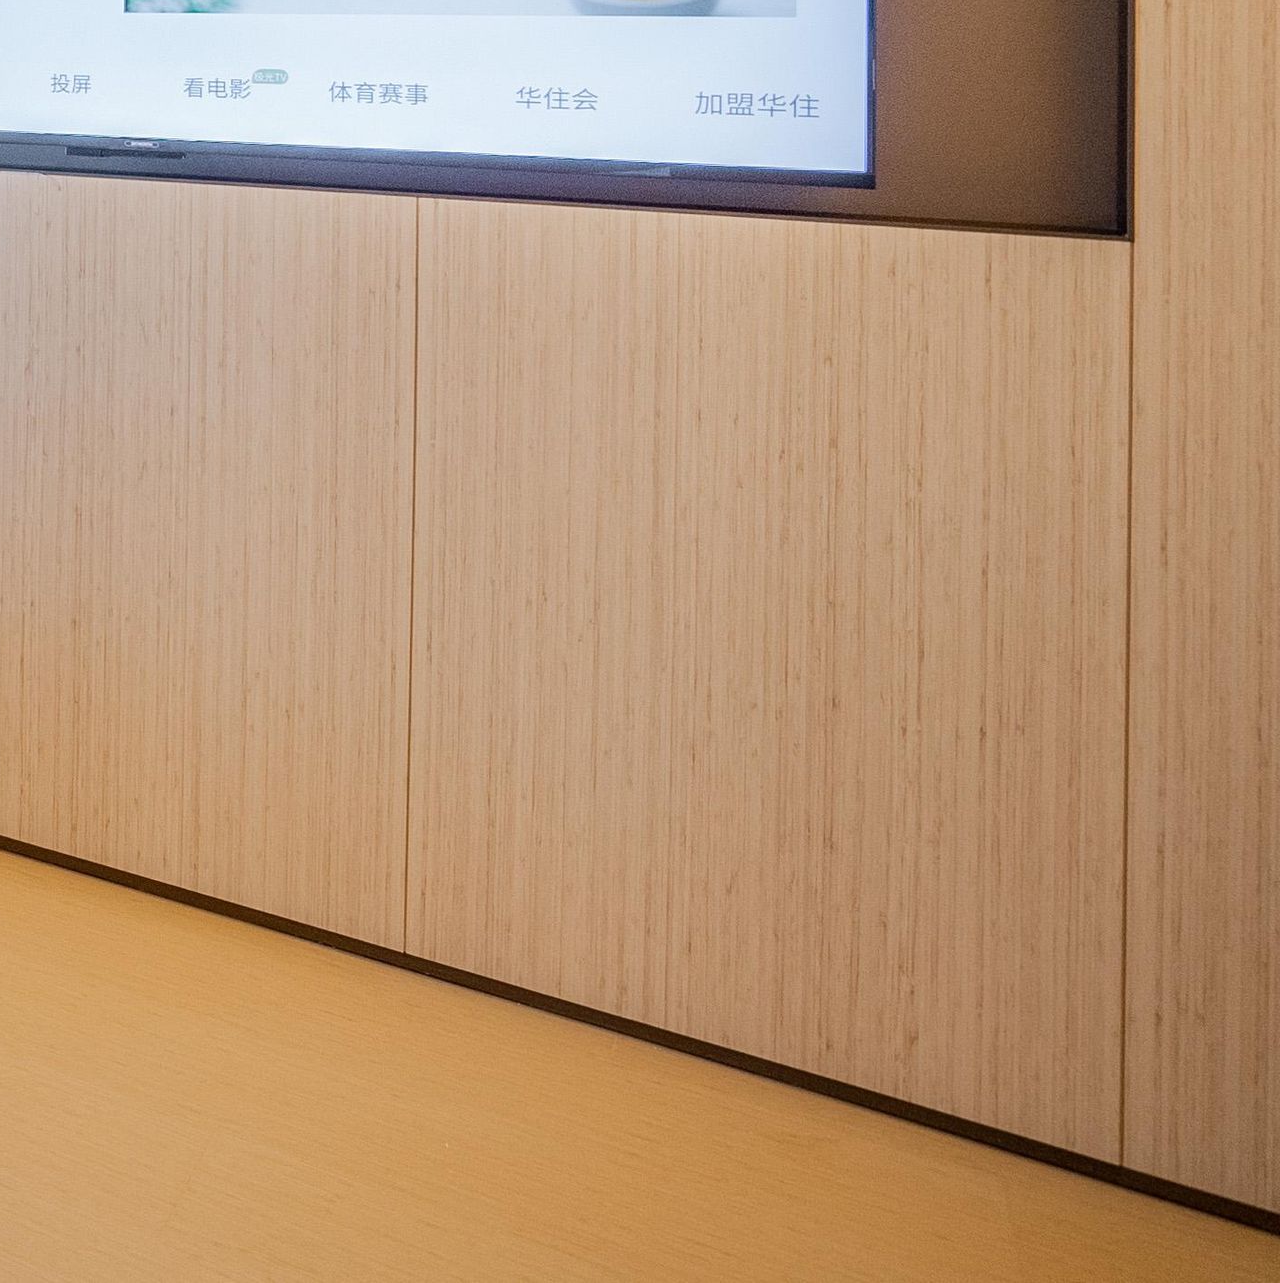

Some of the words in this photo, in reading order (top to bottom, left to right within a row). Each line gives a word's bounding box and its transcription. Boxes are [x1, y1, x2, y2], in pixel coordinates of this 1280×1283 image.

[50, 73, 92, 96] 投屏
[183, 77, 252, 100] 看电影
[328, 80, 429, 106] 体育赛事
[514, 85, 599, 111] 华住会
[694, 90, 820, 119] 加盟华住
